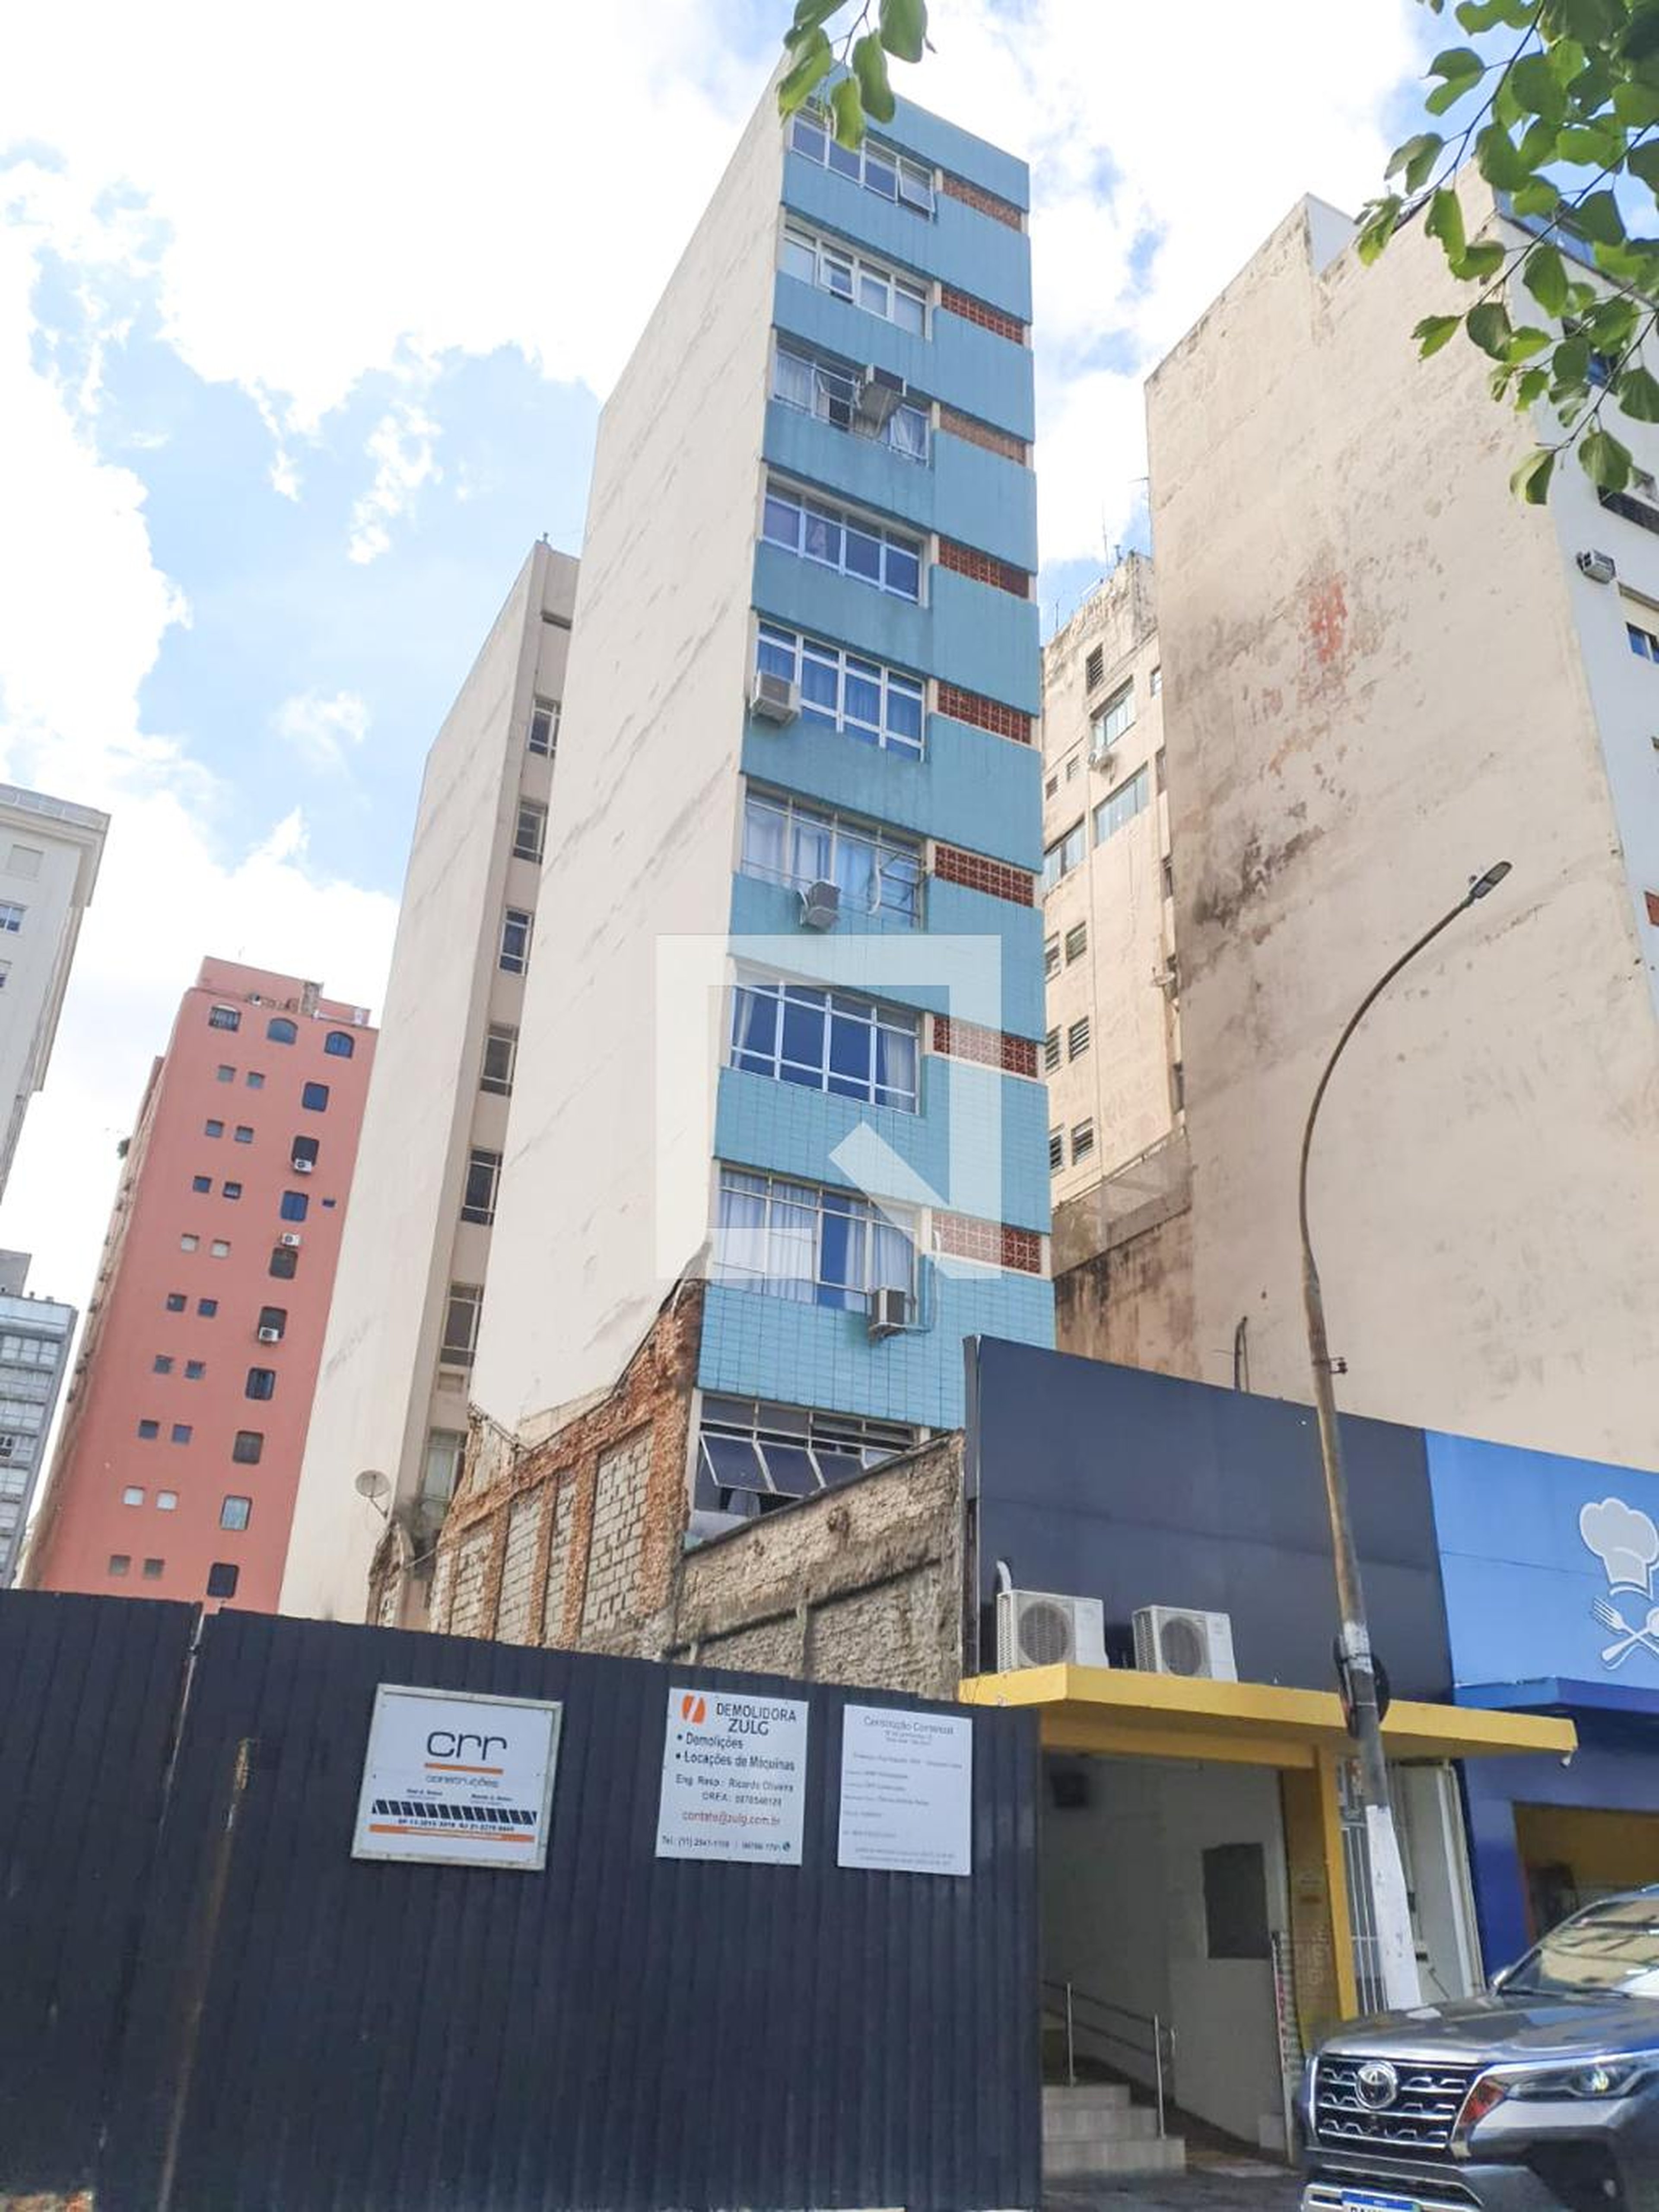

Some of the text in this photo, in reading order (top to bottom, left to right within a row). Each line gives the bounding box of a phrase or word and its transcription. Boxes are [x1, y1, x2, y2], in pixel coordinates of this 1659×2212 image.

[717, 1703, 796, 1722] DEMOLIDORA
[728, 1719, 769, 1736] ZULG
[426, 1731, 507, 1761] crr
[686, 1732, 744, 1749] Demolições
[684, 1751, 732, 1766] Locações
[735, 1756, 747, 1766] de
